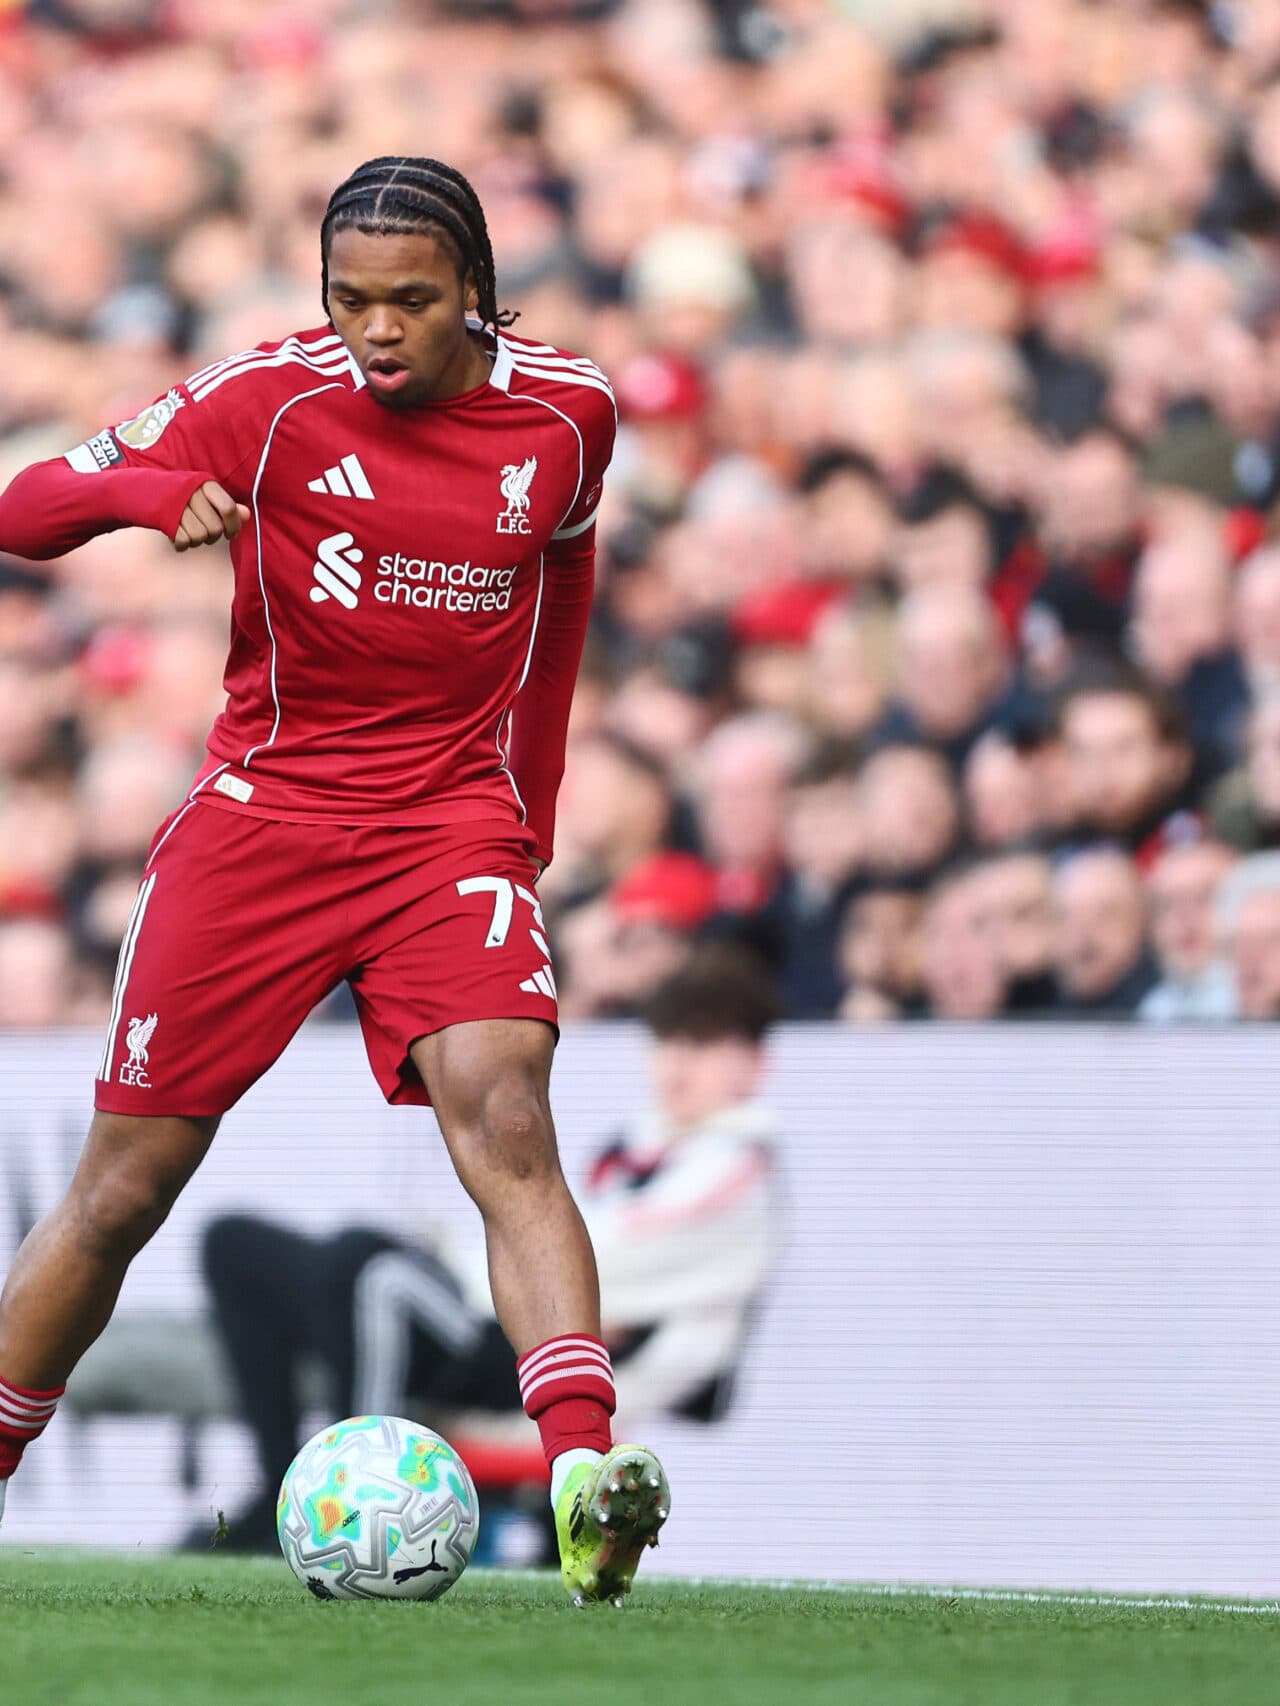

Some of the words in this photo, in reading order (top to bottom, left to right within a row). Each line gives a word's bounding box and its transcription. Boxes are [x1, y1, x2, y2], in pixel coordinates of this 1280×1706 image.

[496, 516, 532, 535] L.F.C.
[377, 552, 517, 588] standard
[373, 577, 513, 612] chartered
[119, 1066, 152, 1089] L.F.C.
